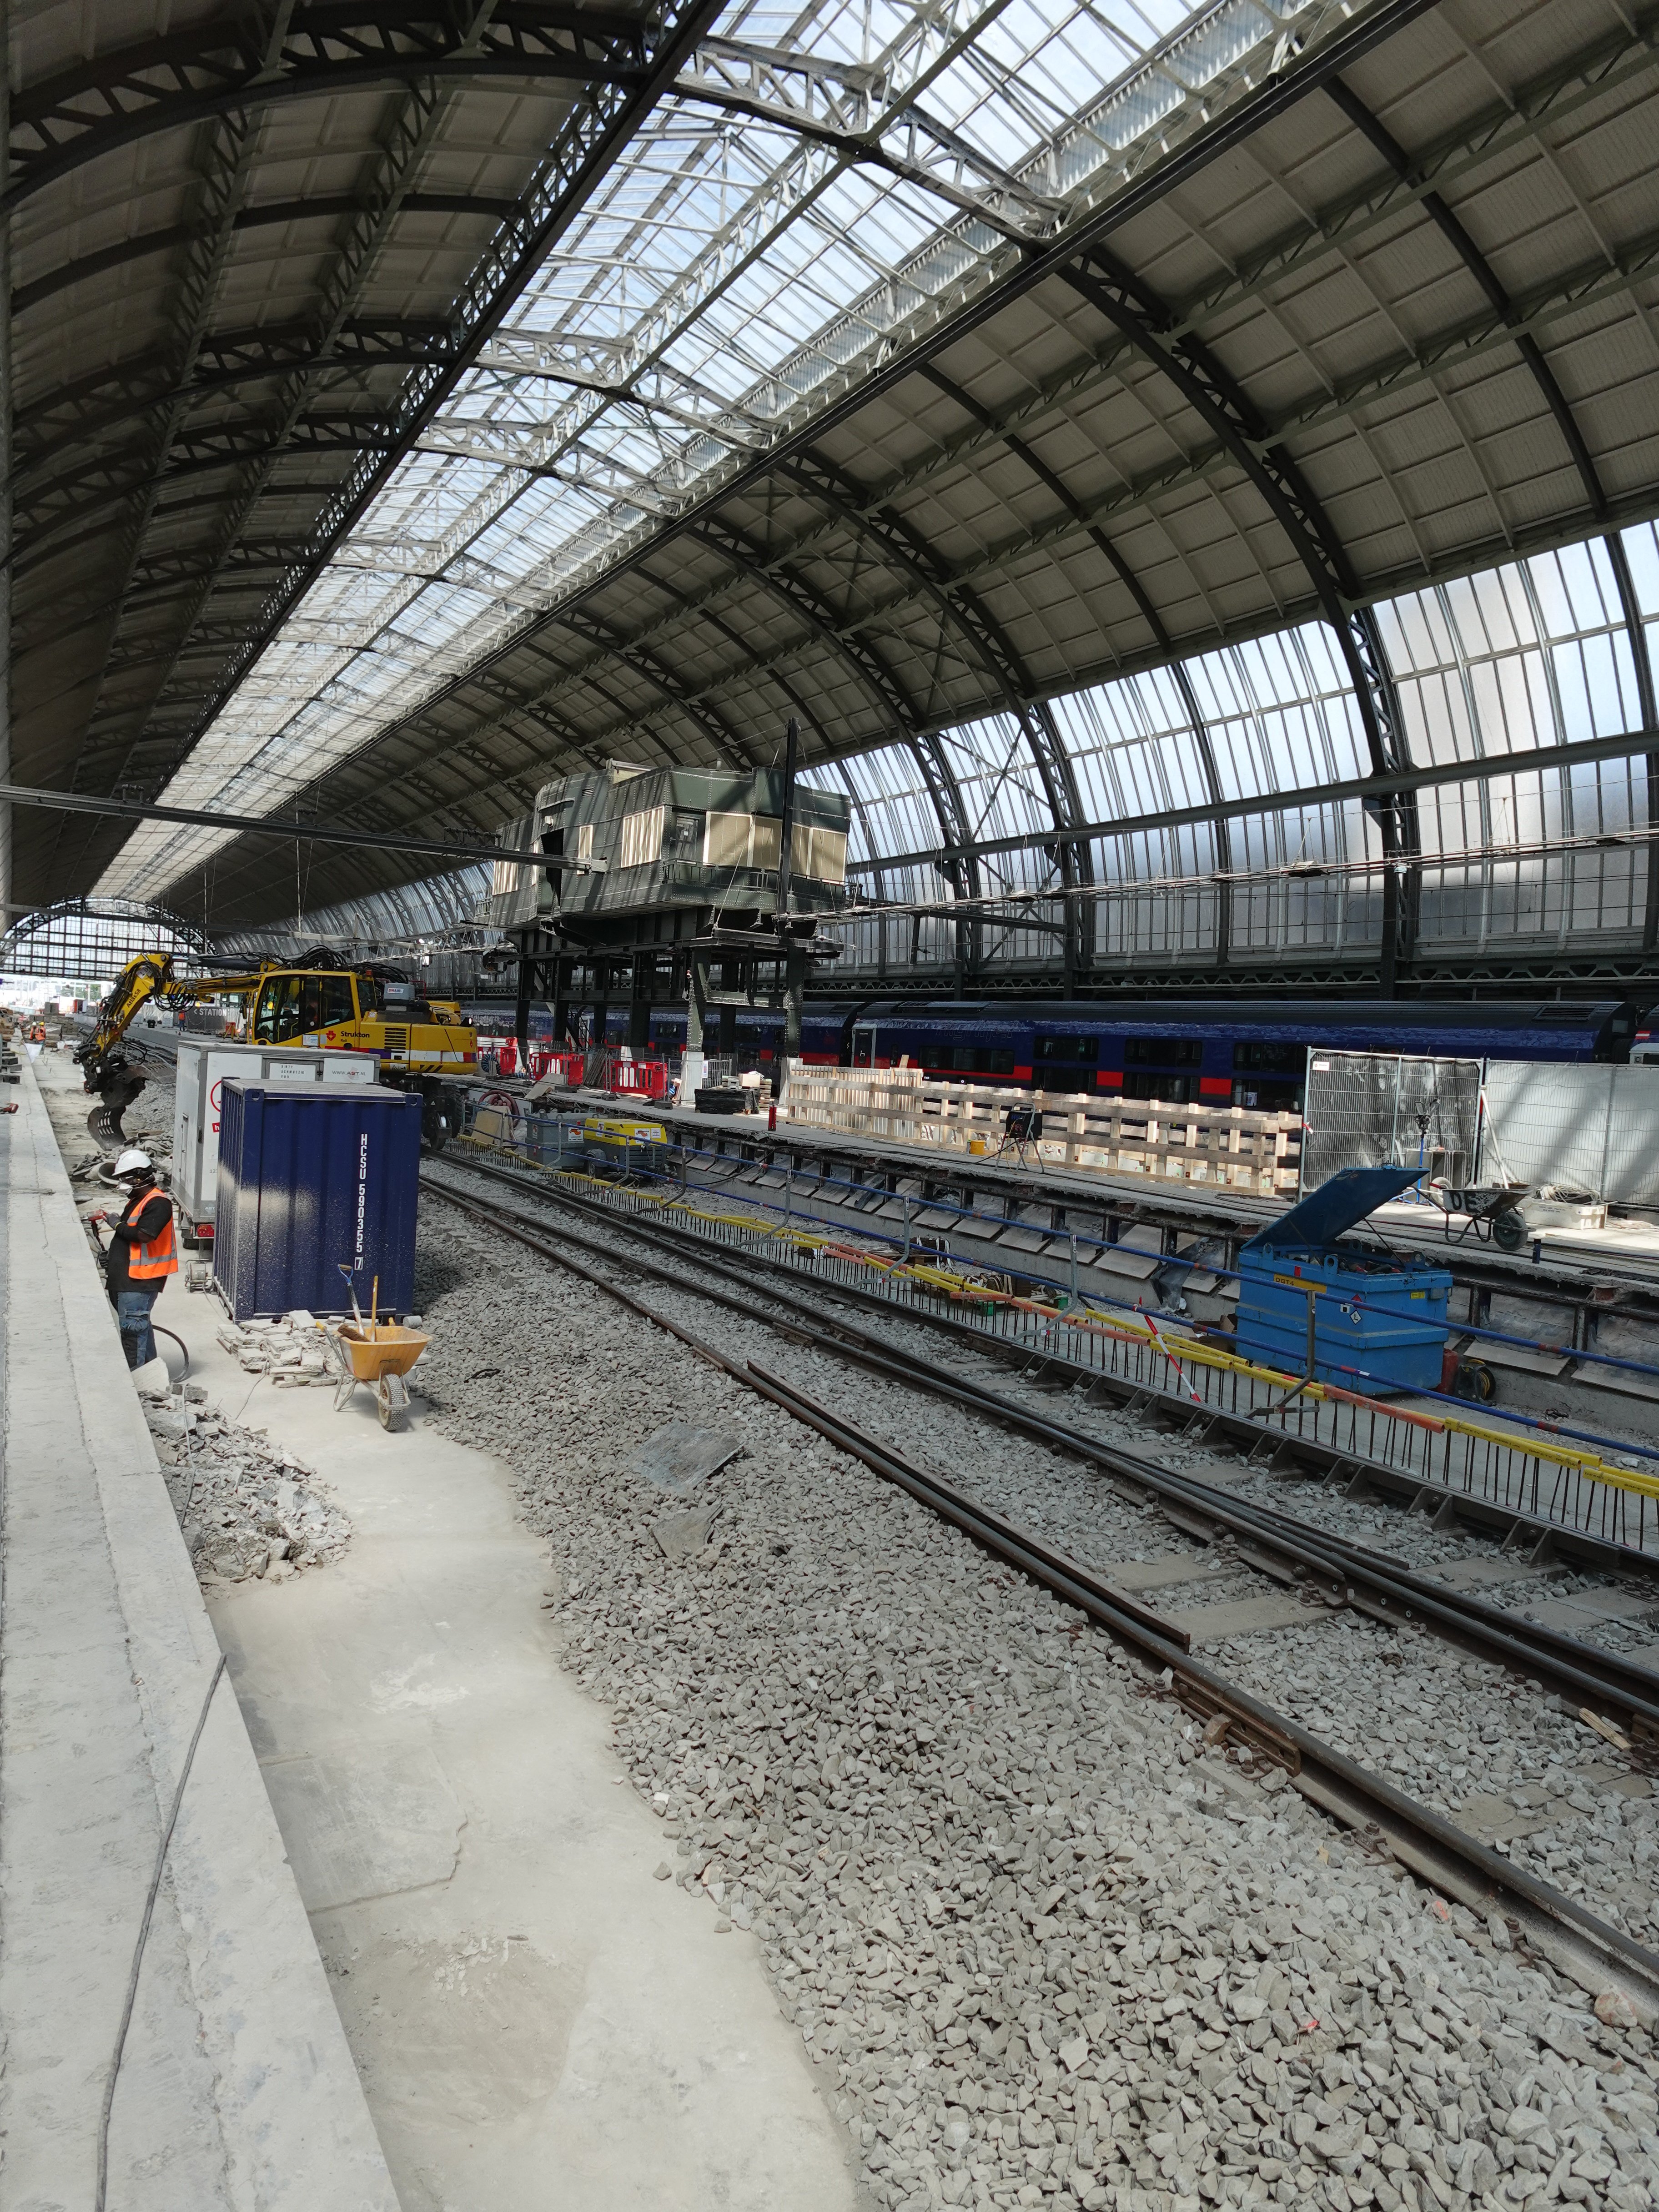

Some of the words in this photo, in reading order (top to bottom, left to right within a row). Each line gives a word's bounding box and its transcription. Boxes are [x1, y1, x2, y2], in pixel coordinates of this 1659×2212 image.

[126, 988, 141, 1008] Atlas58
[199, 1006, 227, 1016] STATION
[359, 1133, 367, 1180] HCSU
[356, 1184, 365, 1252] 590355
[1624, 1483, 1651, 1493] SAFETY
